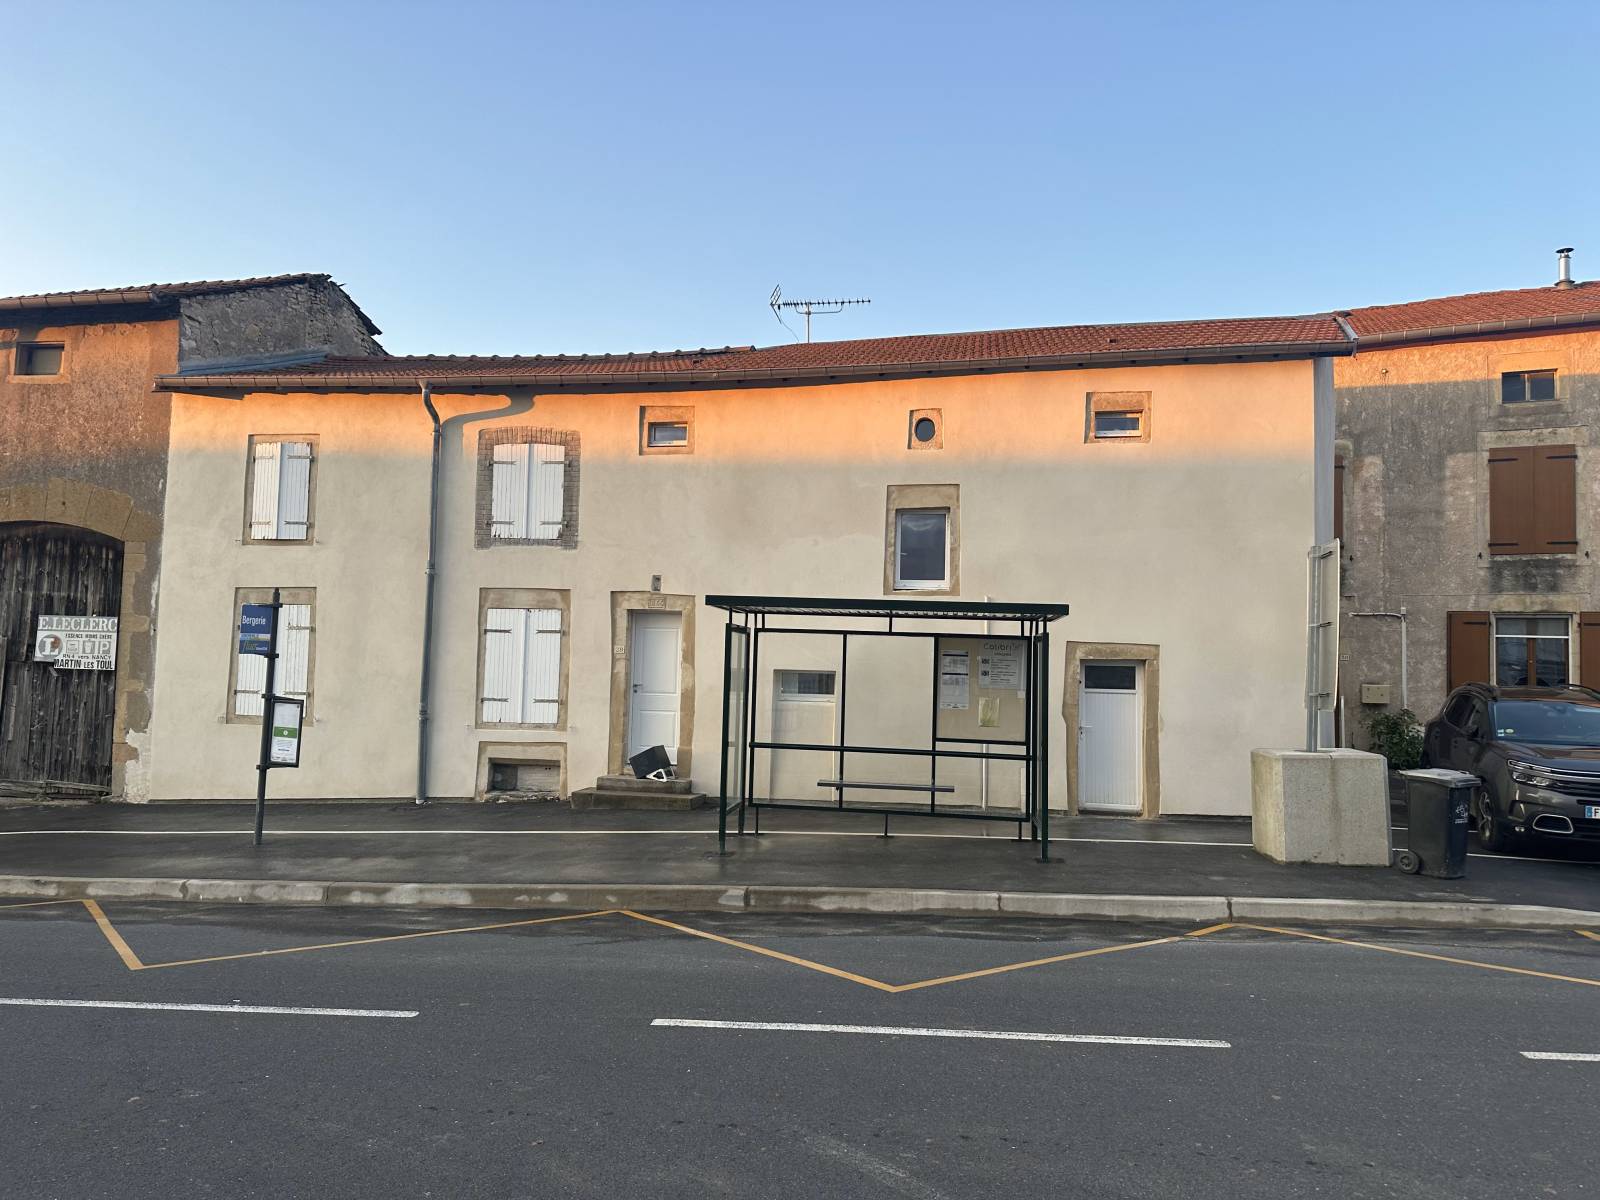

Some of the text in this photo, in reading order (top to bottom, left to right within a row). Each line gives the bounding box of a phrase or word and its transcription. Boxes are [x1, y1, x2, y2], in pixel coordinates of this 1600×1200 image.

[38, 616, 117, 631] E.LECLERC
[242, 615, 266, 627] Bergerie
[53, 658, 81, 668] MARTIN
[96, 660, 113, 669] TOUL
